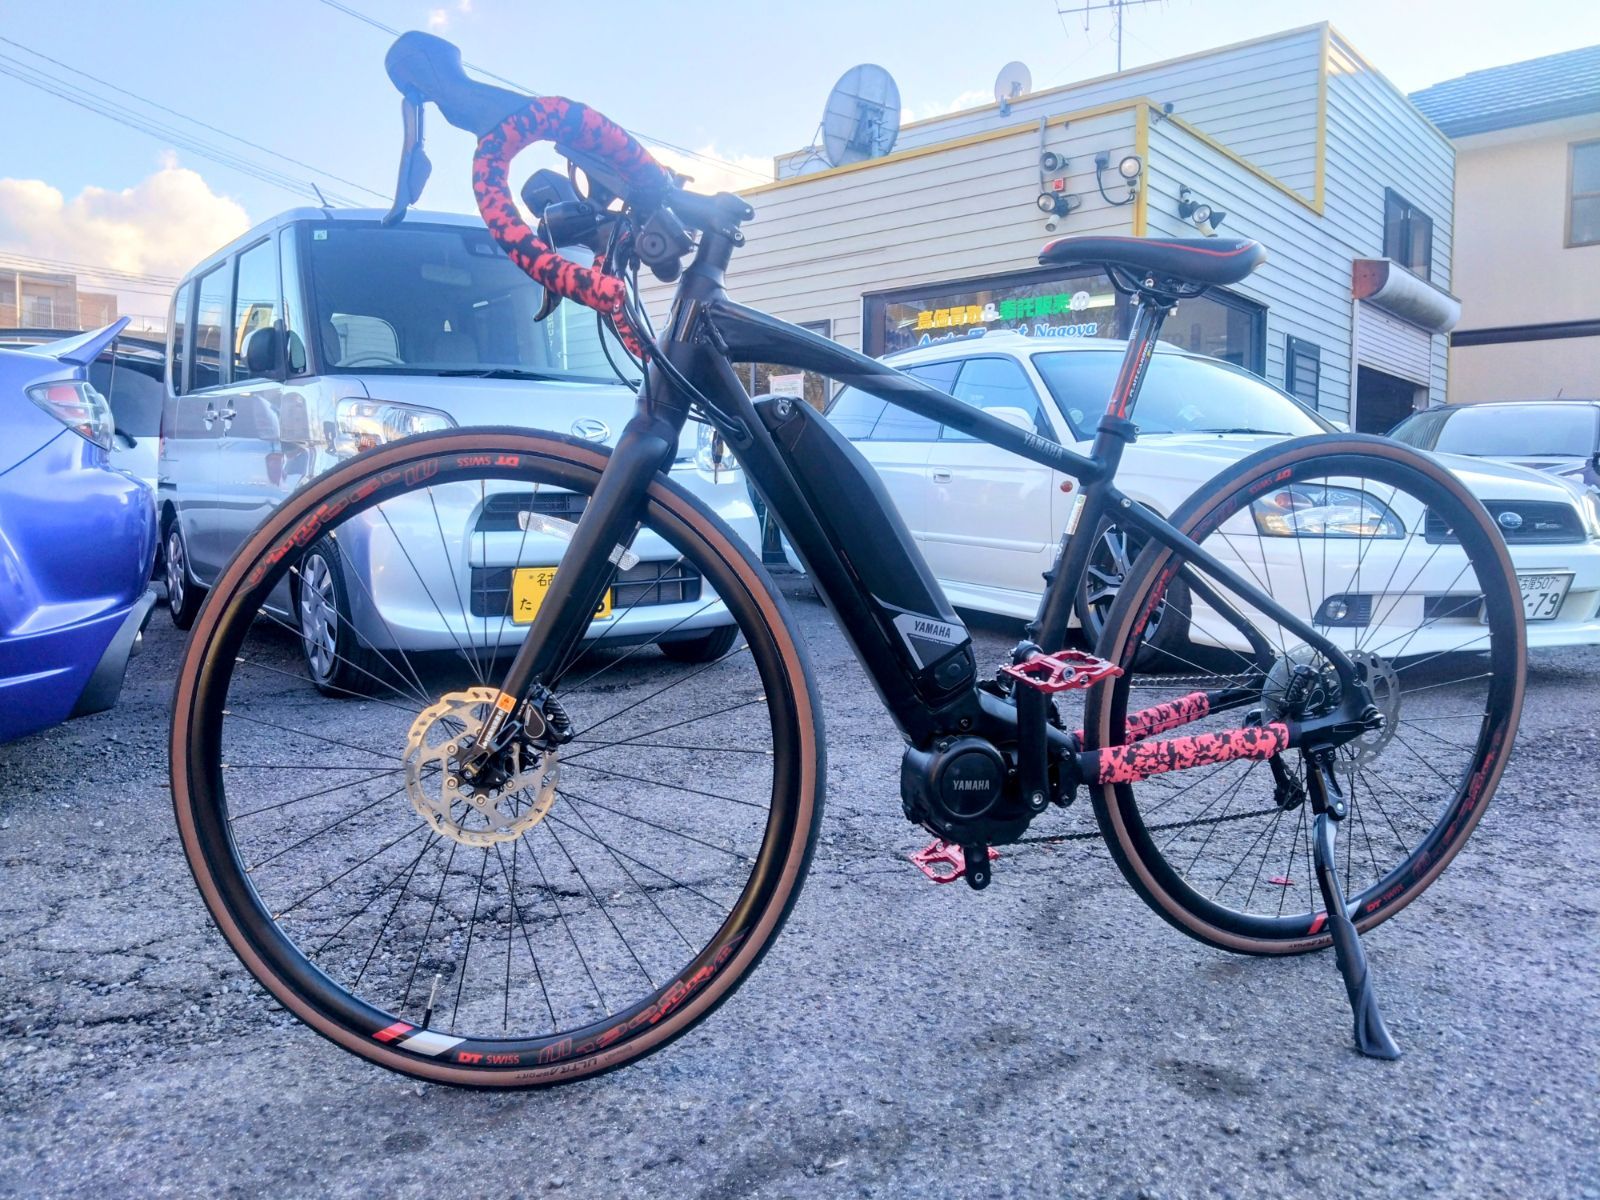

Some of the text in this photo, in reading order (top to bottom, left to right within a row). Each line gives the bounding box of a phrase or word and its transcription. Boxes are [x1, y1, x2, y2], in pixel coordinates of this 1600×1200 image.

[1023, 432, 1064, 460] YAMAHA
[457, 456, 491, 467] SWISS
[914, 620, 952, 639] YAMAHA
[952, 779, 991, 791] YAMAHA
[457, 1051, 521, 1065] DT SWISS
